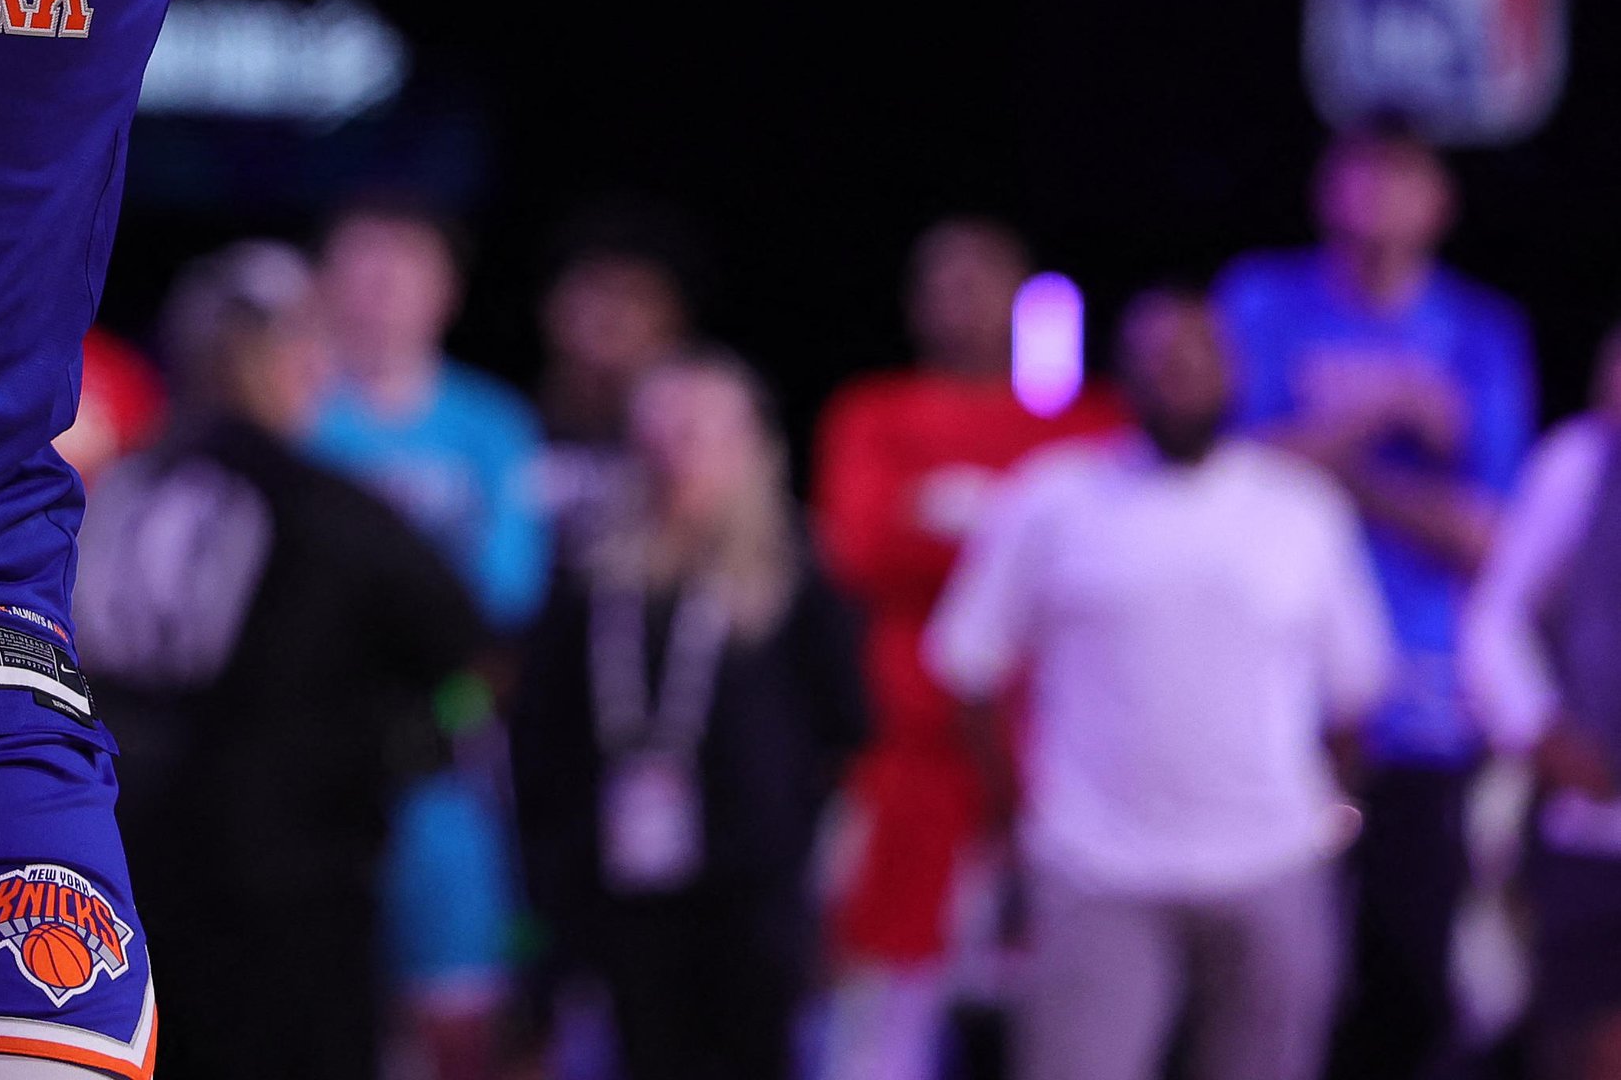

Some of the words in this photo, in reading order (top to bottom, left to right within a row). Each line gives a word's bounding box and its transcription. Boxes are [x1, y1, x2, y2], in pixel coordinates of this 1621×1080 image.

[11, 606, 47, 627] ALWAYS
[28, 869, 57, 881] NEW
[59, 871, 90, 896] YORK
